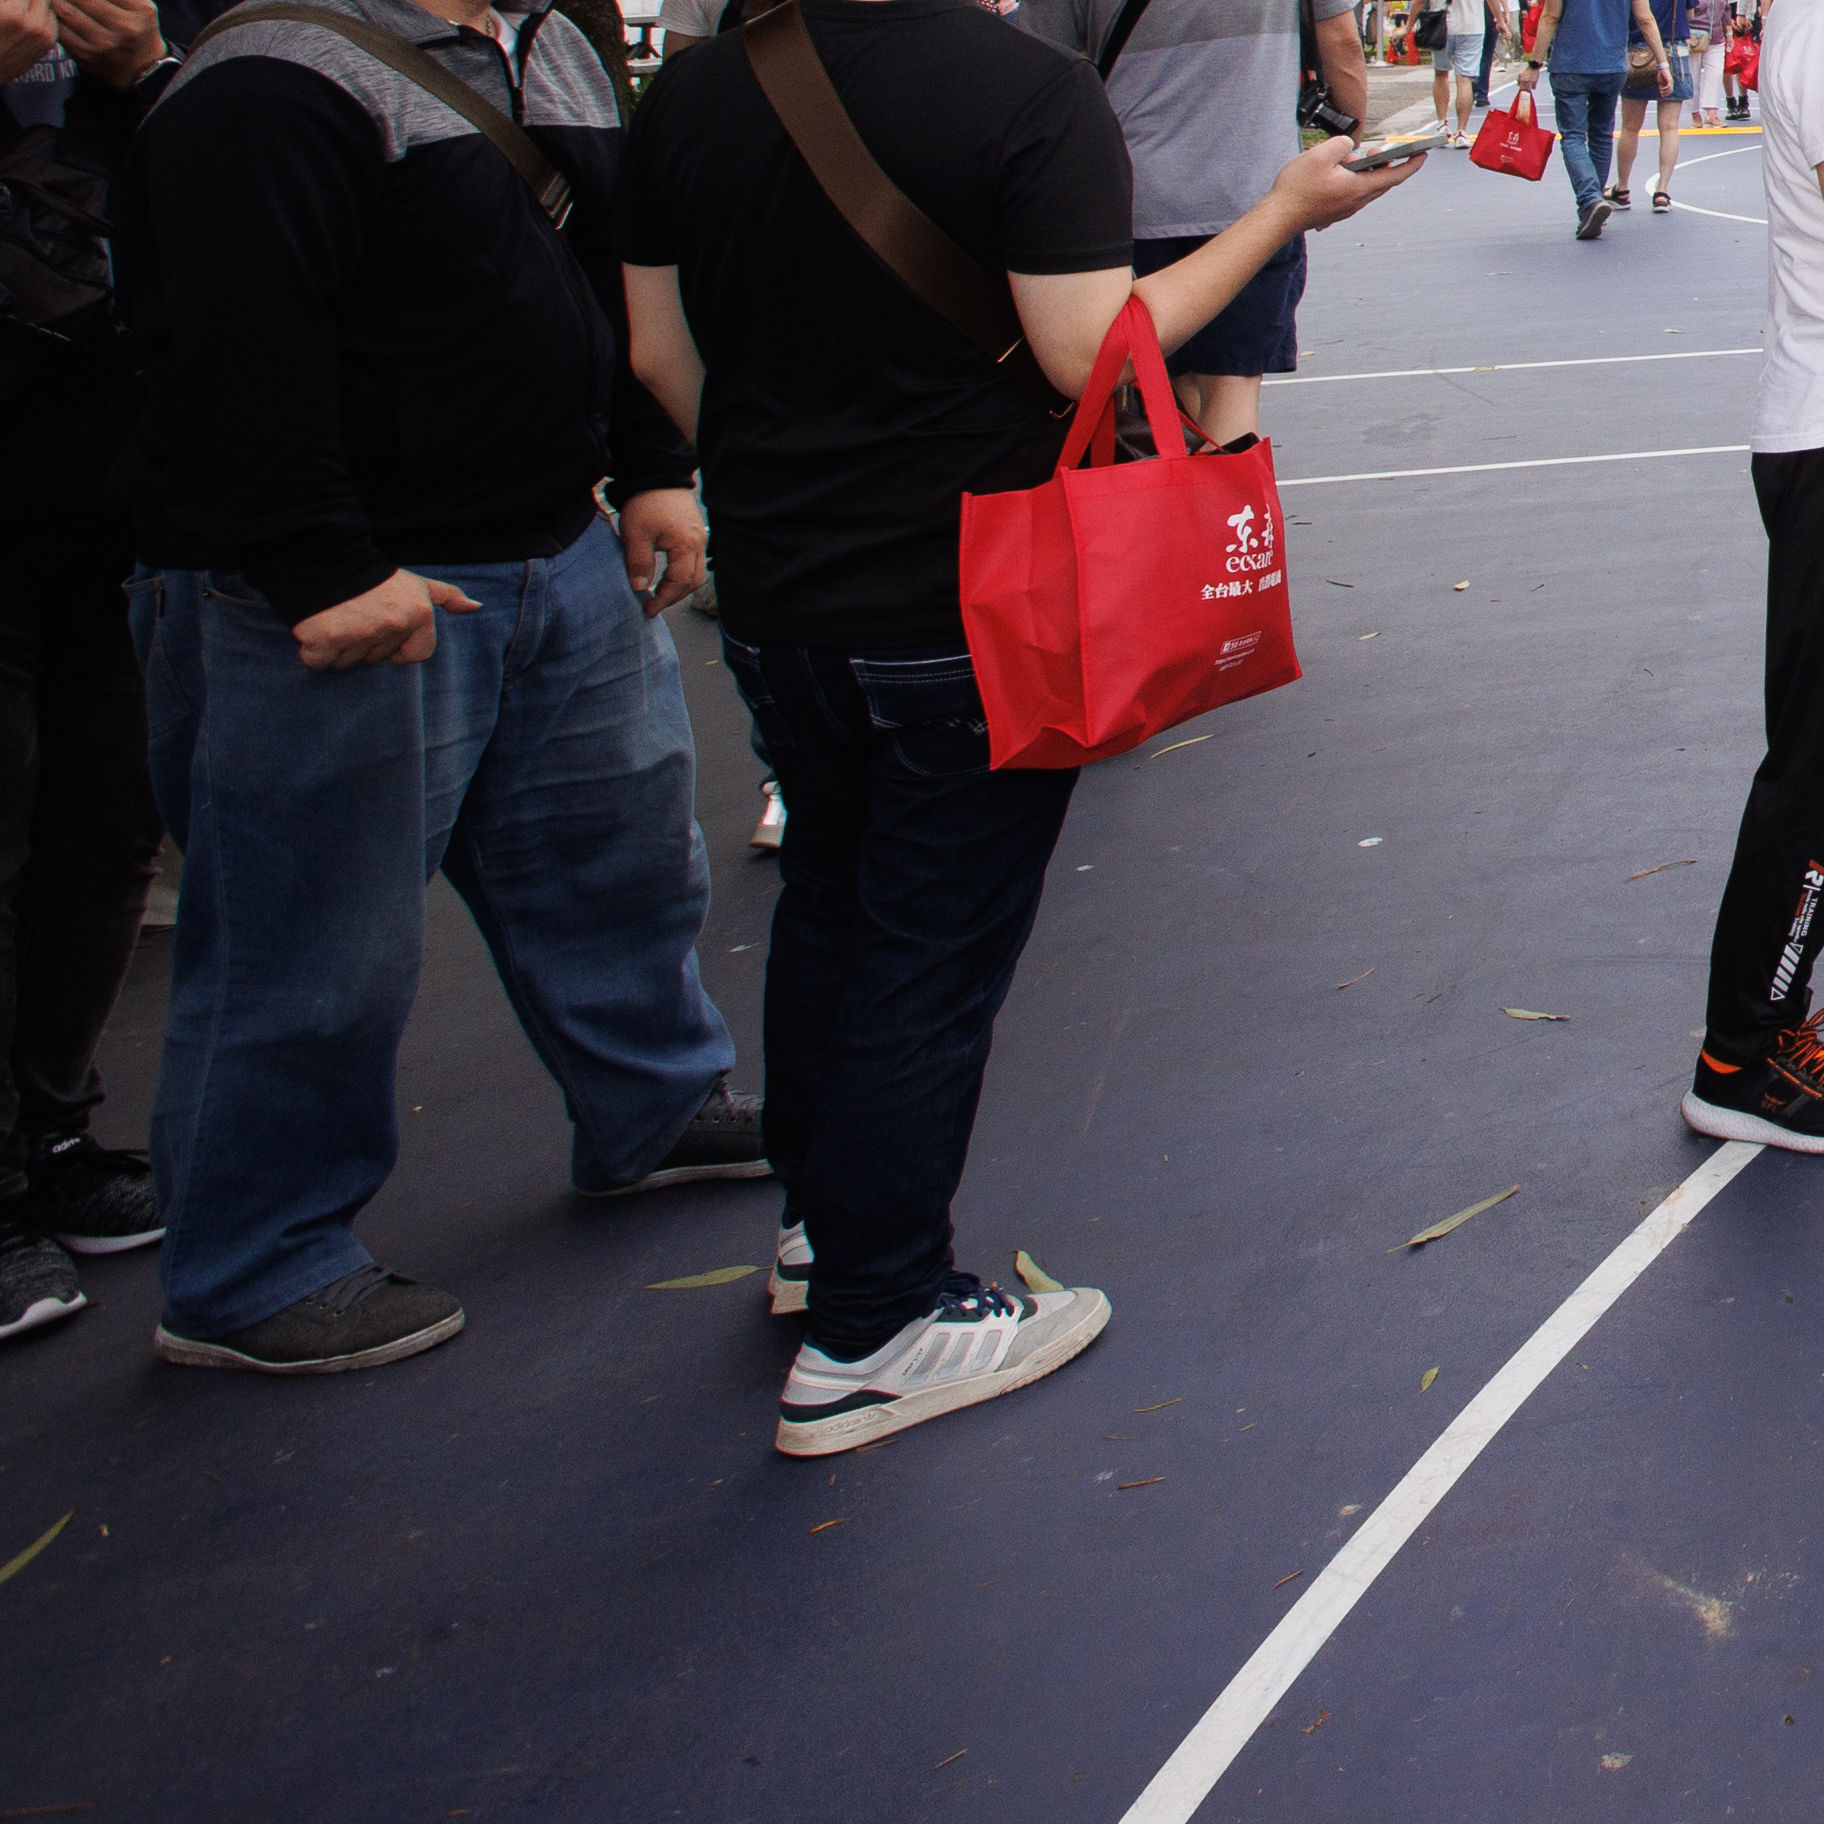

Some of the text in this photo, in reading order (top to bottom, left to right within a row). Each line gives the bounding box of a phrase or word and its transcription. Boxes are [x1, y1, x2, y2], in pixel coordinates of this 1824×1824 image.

[1200, 579, 1254, 601] 全台最大
[1800, 897, 1819, 937] TRAINING
